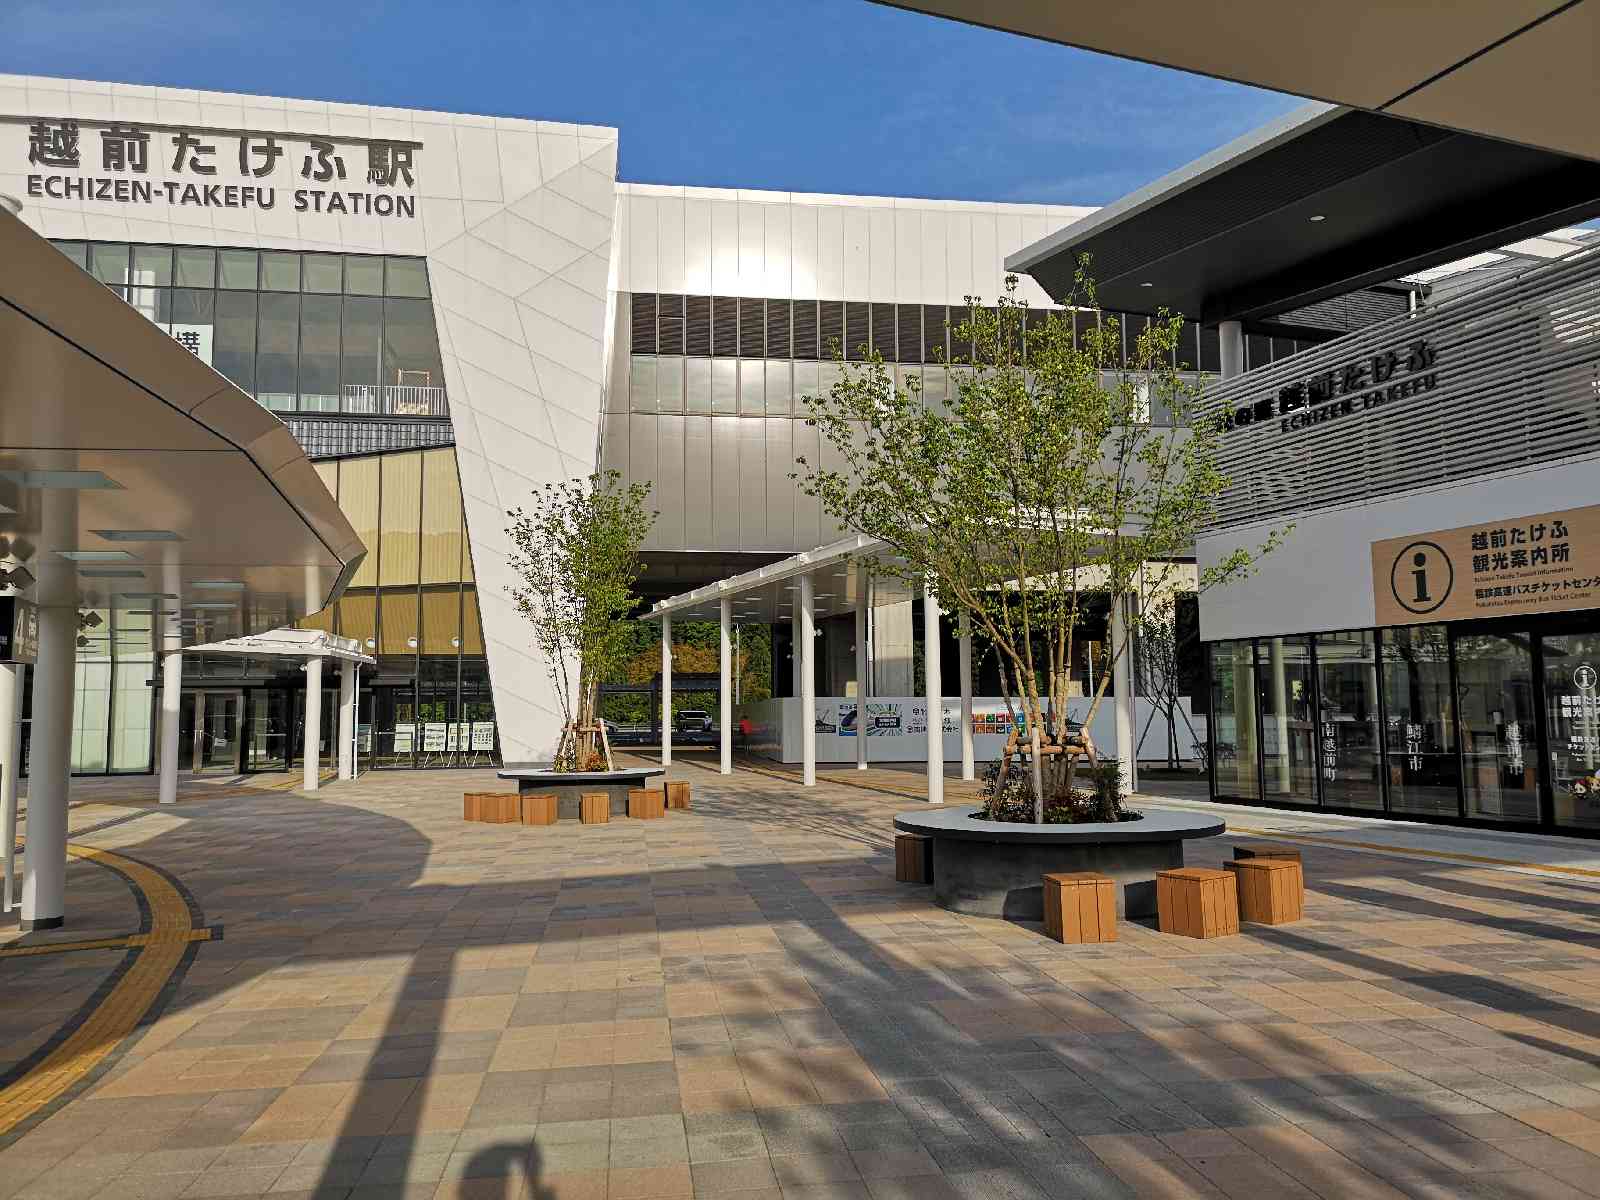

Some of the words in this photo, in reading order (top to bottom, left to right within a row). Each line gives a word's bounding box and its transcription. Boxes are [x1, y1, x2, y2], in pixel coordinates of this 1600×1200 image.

[28, 121, 416, 187] 越前たけふ駅
[26, 174, 276, 210] ECHIZEN-TAKEFU
[293, 189, 416, 218] STATION
[1472, 520, 1569, 551] 越前たけふ
[1472, 542, 1570, 573] 観光案内所
